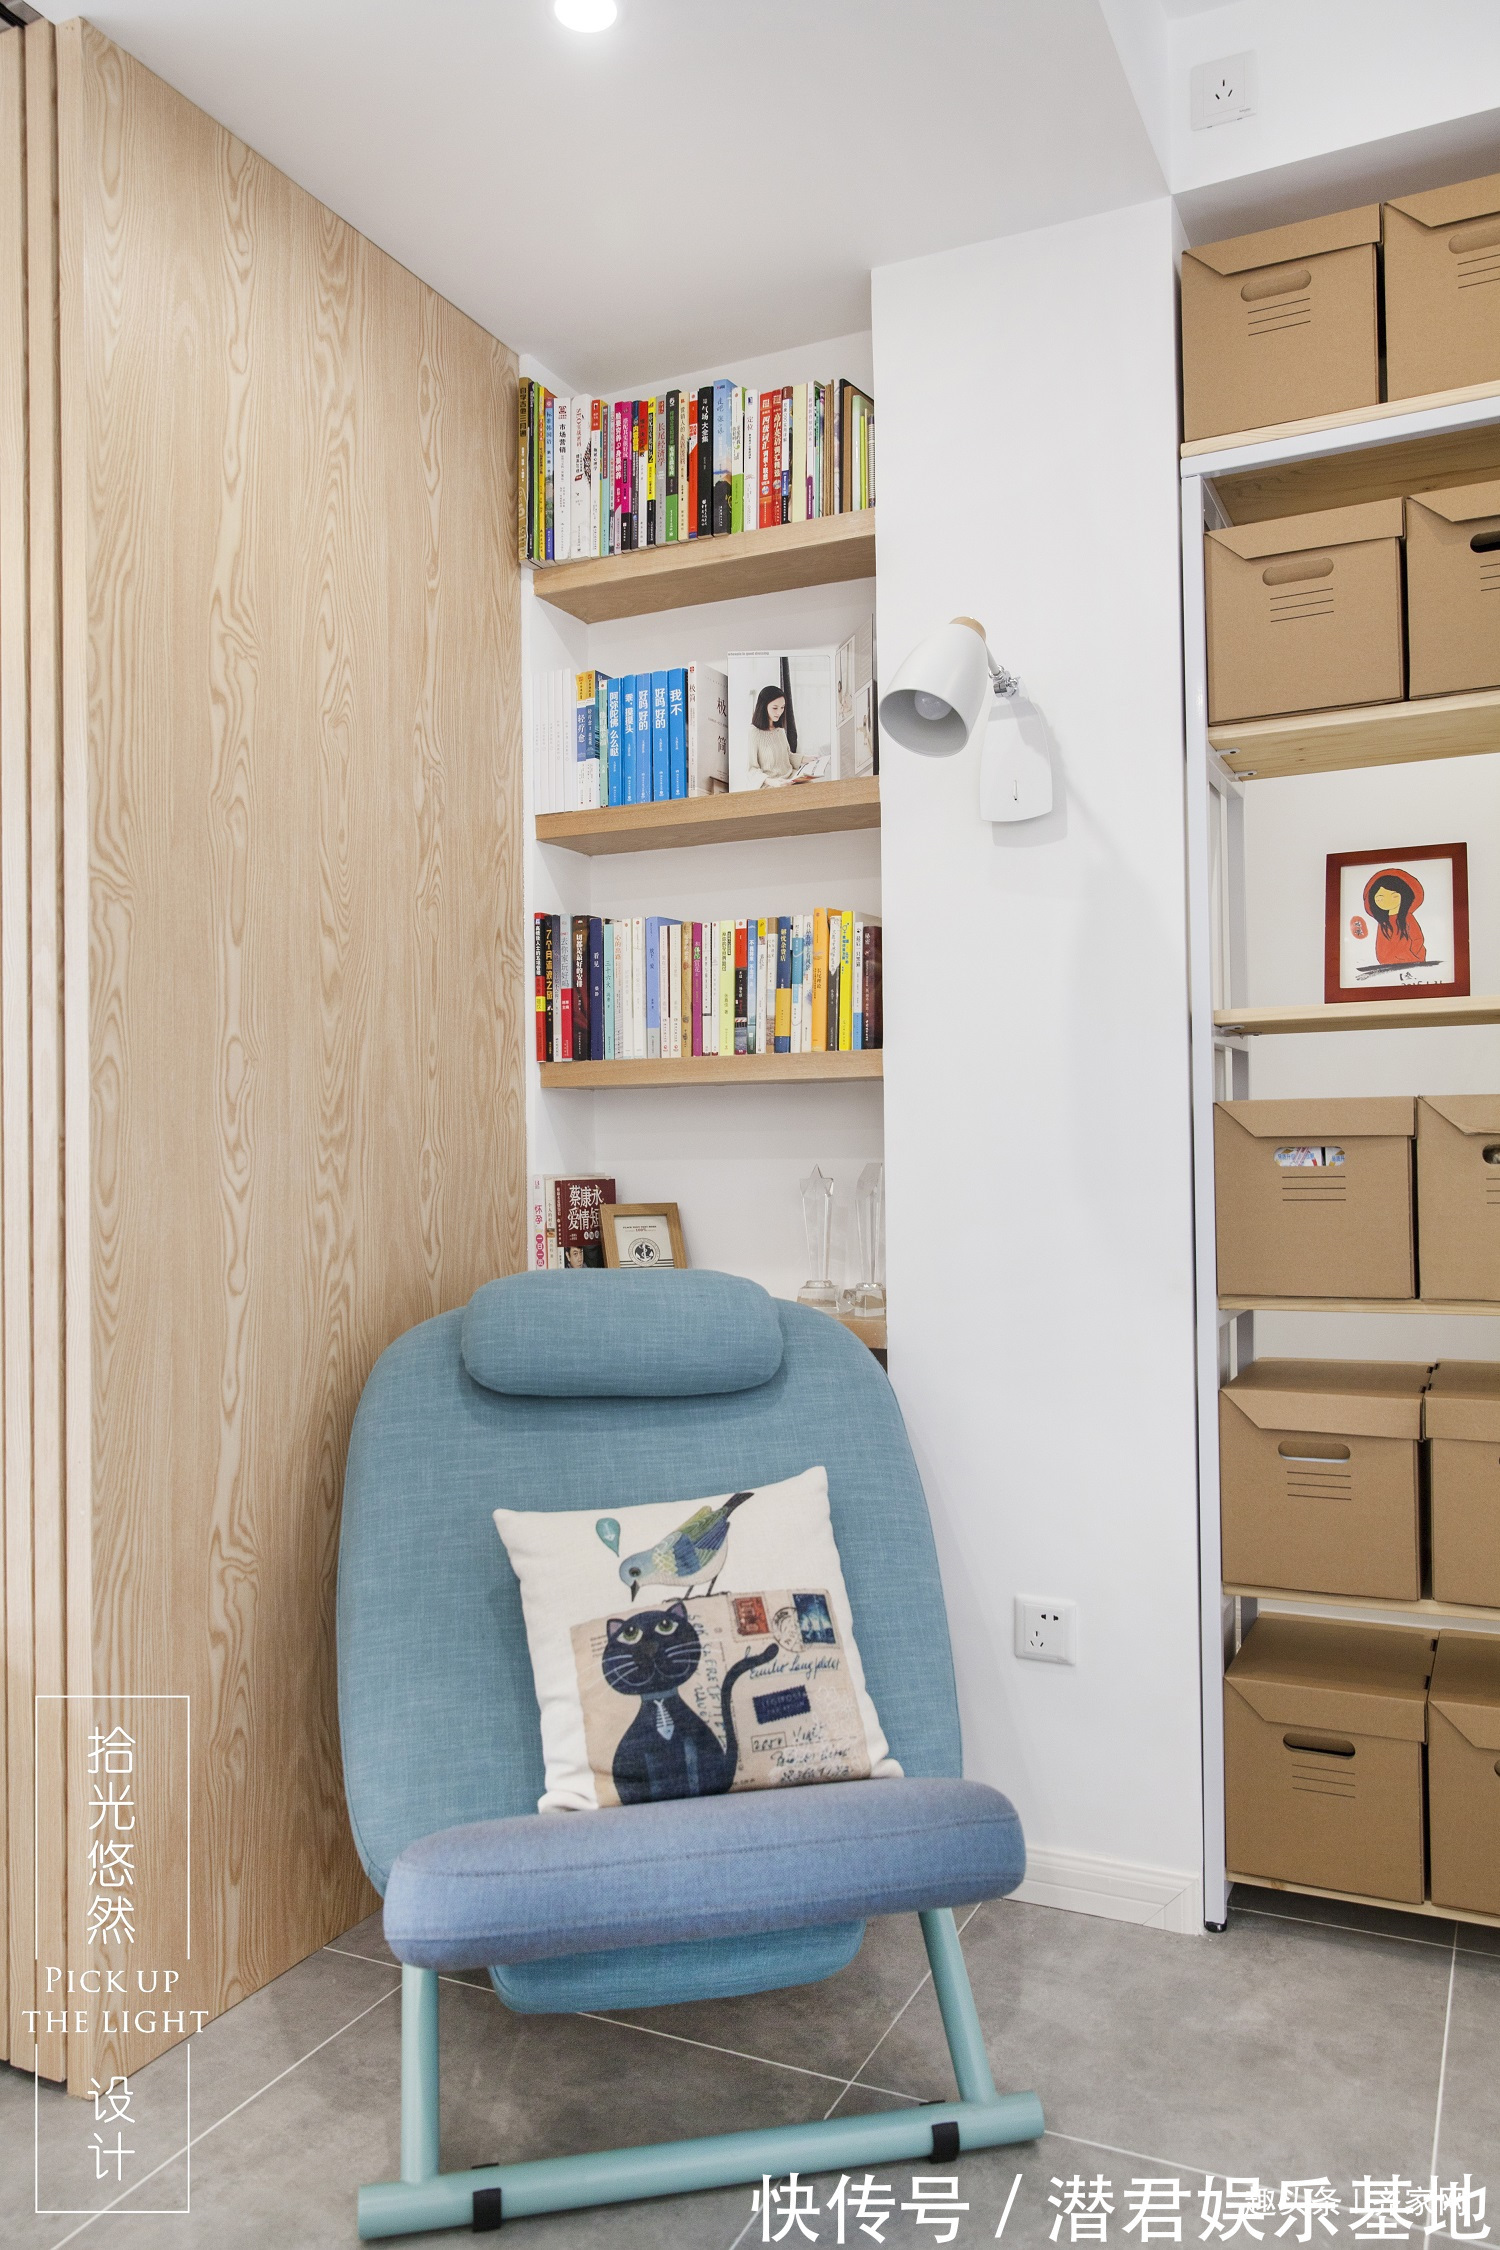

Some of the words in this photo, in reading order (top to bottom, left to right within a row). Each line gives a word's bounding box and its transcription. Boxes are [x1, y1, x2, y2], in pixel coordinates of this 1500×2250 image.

[747, 416, 753, 431] 定位
[657, 422, 665, 467] 长尾经济学
[638, 690, 648, 709] 好吗
[655, 688, 665, 707] 好吗
[670, 689, 682, 716] 我不
[609, 692, 619, 727] 阿弥陀佛
[655, 709, 666, 729] 好的
[577, 714, 586, 743] 轻疗愈
[638, 711, 648, 731] 好的
[610, 730, 619, 757] 么么哒
[569, 1184, 603, 1207] 蔡康永
[534, 1205, 543, 1225] 怀孕
